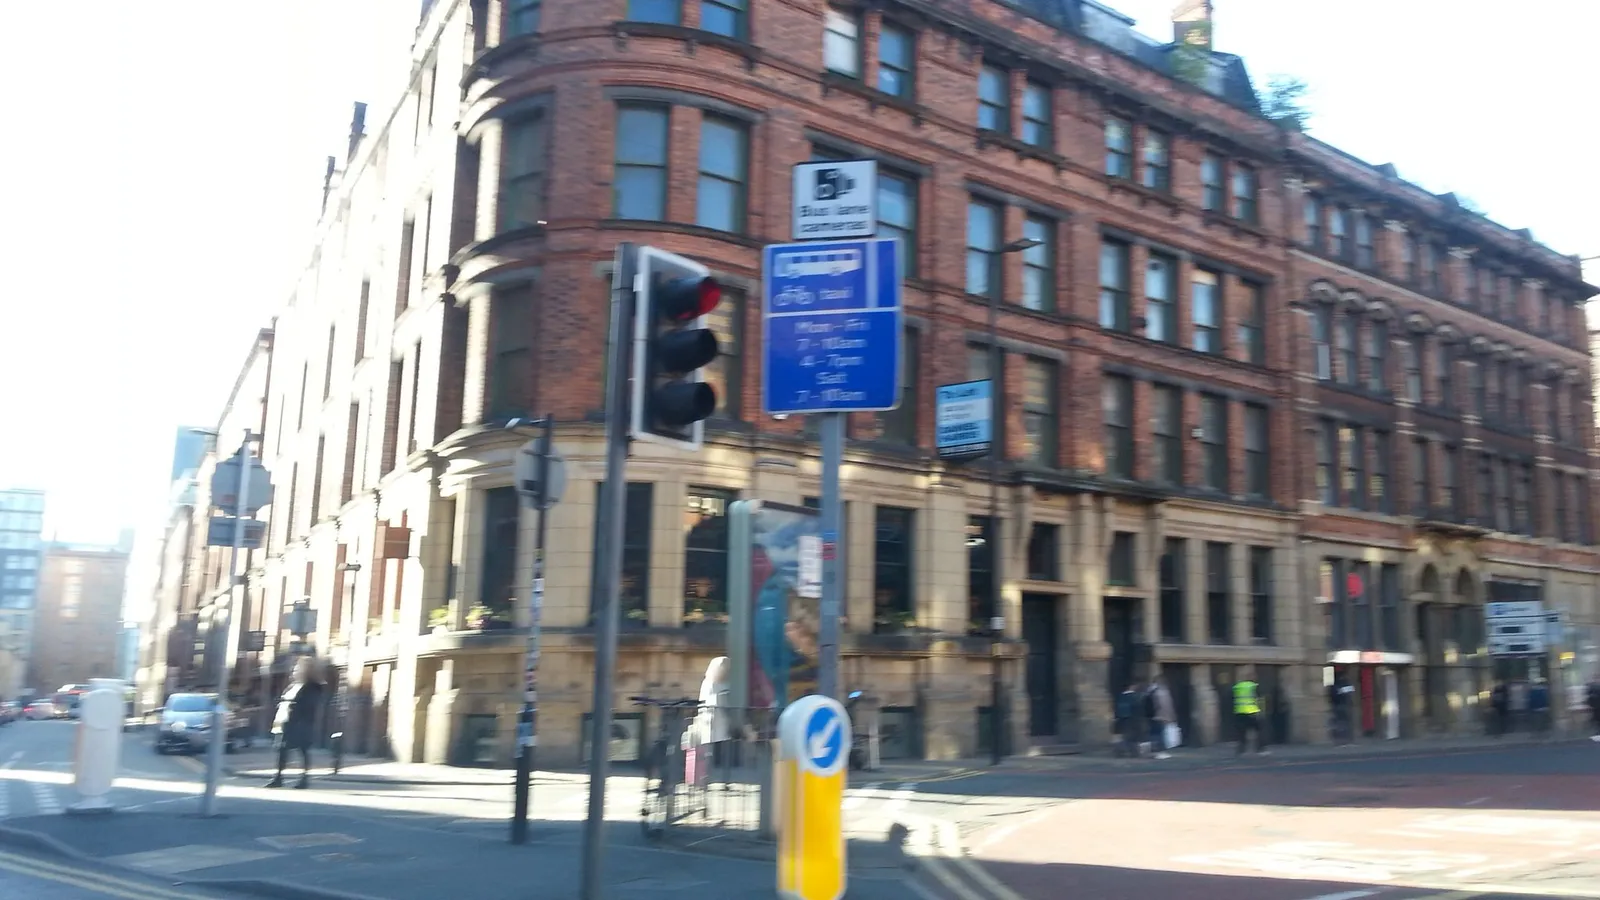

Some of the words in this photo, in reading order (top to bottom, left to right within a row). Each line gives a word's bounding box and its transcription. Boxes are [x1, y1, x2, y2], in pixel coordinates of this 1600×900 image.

[800, 204, 830, 217] Bus
[837, 203, 870, 216] lane
[801, 221, 869, 233] cameras
[819, 286, 854, 300] taxi
[795, 321, 833, 334] Mon
[843, 318, 870, 332] Fri
[815, 371, 848, 385] Sat
